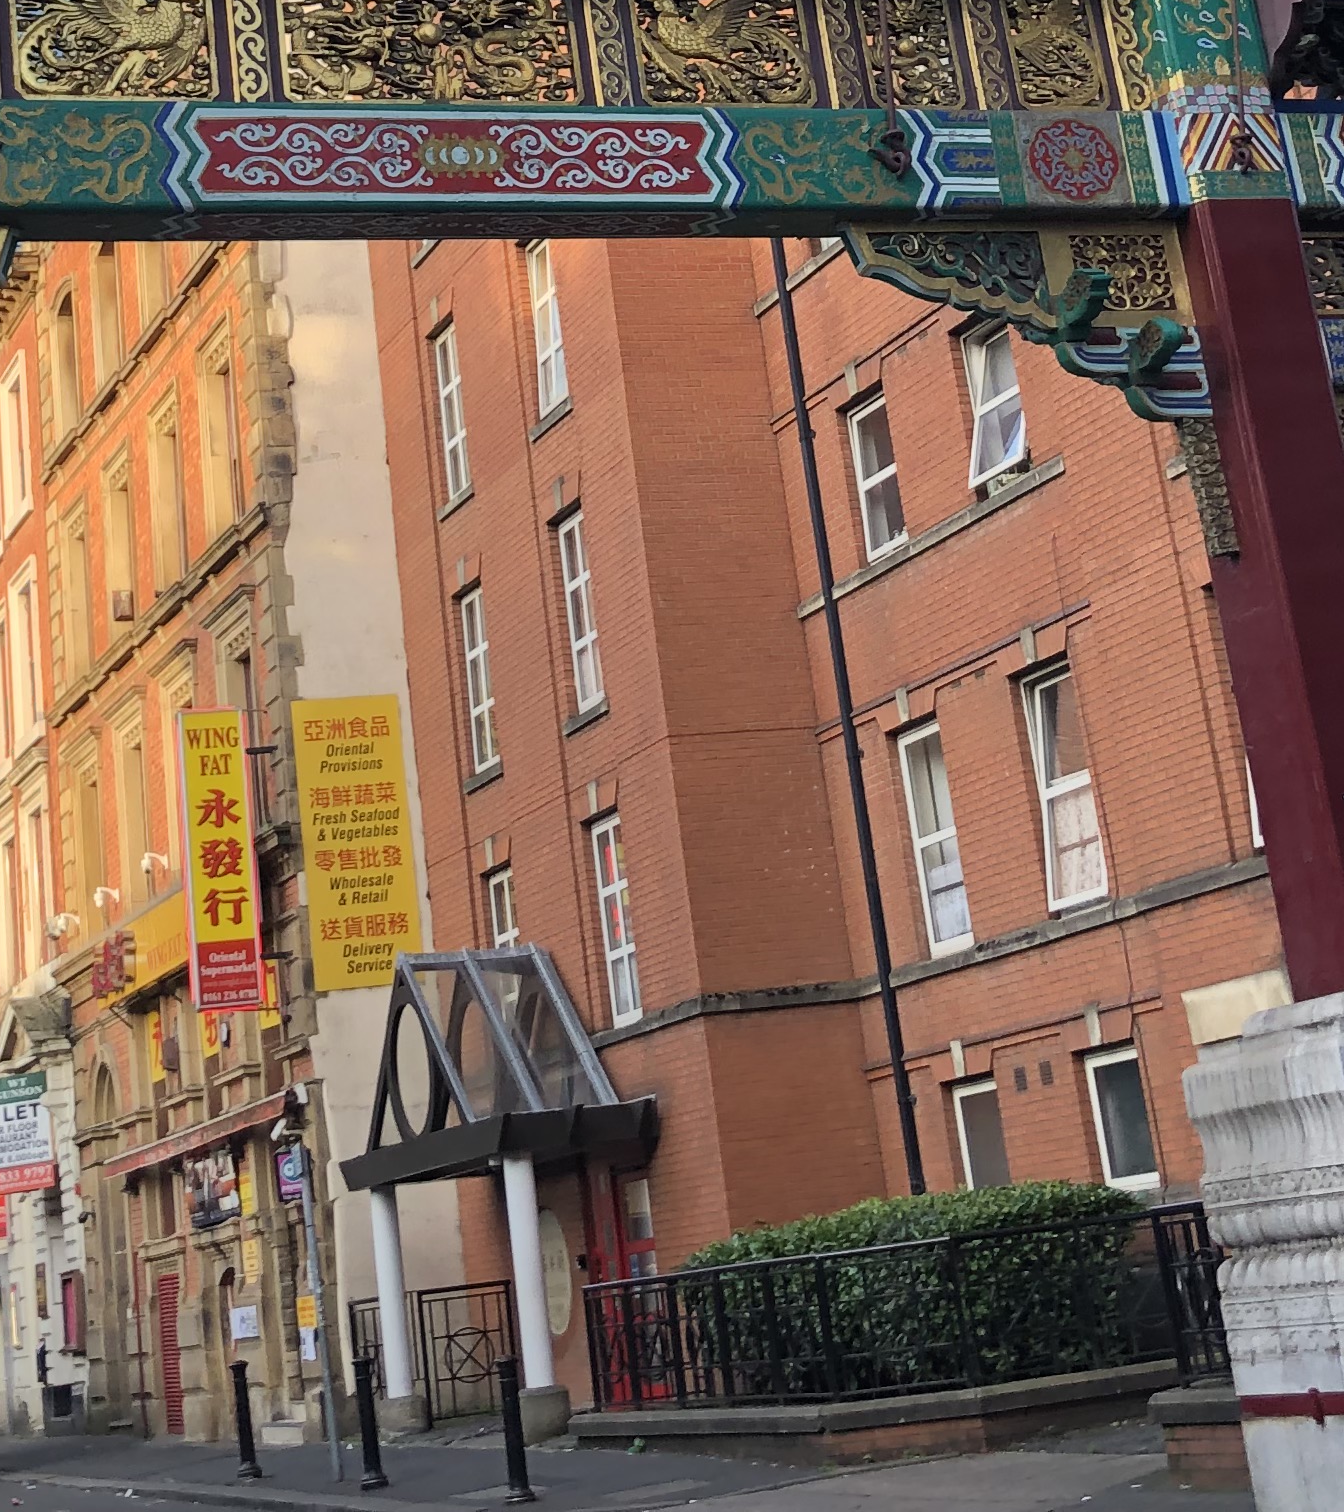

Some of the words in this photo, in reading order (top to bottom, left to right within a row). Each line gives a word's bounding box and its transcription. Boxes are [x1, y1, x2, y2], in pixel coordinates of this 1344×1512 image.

[186, 726, 240, 749] WING
[303, 715, 390, 742] 亞洲食品
[326, 742, 374, 757] Oriental
[199, 753, 232, 776] FAT
[320, 758, 383, 773] Provisions
[309, 781, 397, 808] 海鮮蔬菜
[312, 811, 346, 826] Fresh
[350, 807, 400, 823] Seafood
[317, 828, 326, 842] &
[331, 823, 398, 842] Vegetables
[196, 788, 249, 926] 永發行
[315, 845, 402, 872] 零售批發
[329, 873, 394, 890] Wholesale
[338, 892, 346, 906] &
[351, 888, 388, 904] Retail
[320, 911, 409, 941] 送貨服務
[208, 950, 246, 963] Oriental
[343, 943, 394, 958] Delivery
[347, 959, 393, 974] Service
[3, 1102, 40, 1122] LET
[7, 1120, 38, 1133] FLOOR
